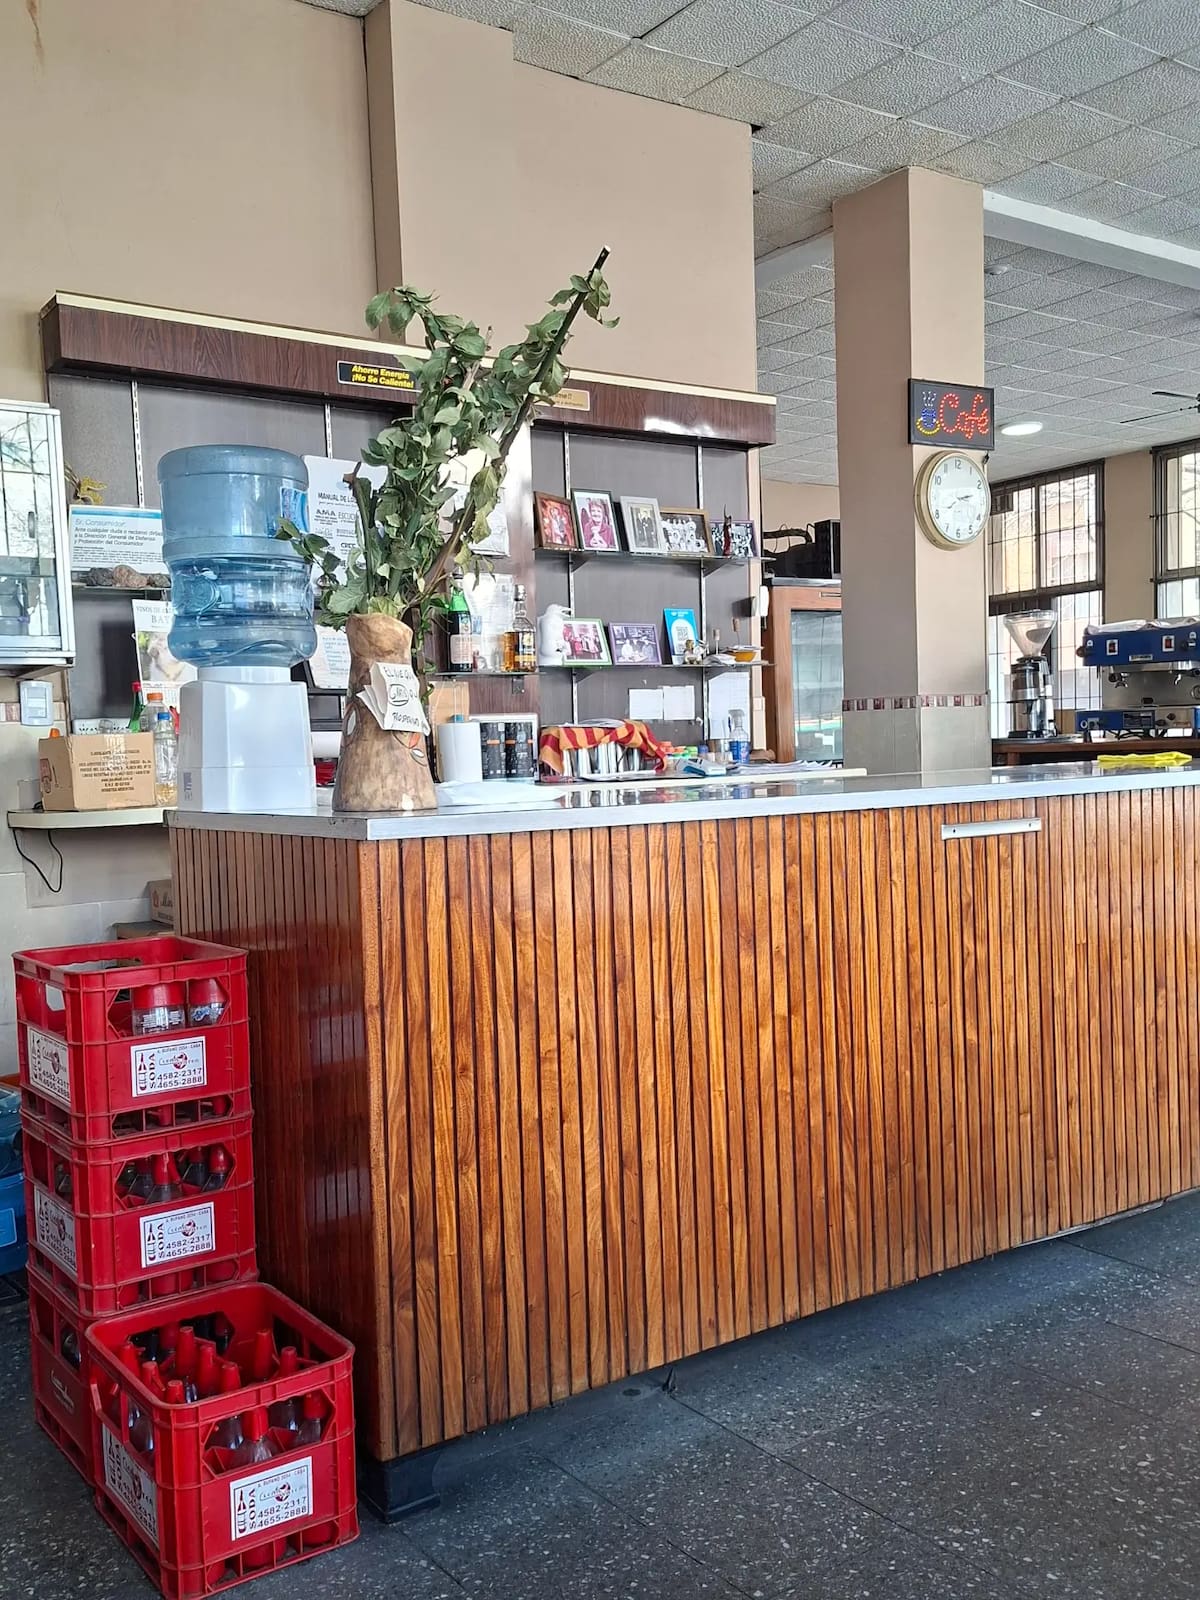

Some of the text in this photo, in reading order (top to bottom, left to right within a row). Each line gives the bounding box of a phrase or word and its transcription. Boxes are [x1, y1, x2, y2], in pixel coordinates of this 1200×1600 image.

[379, 377, 414, 389] Caliente!
[939, 393, 989, 440] Café
[954, 458, 962, 470] 12
[934, 475, 942, 486] 10
[976, 480, 982, 490] 2
[318, 492, 339, 502] MANUAL
[340, 495, 347, 503] DE
[934, 509, 940, 519] 8
[85, 519, 126, 527] Consumidor
[968, 524, 973, 535] 5
[955, 528, 961, 538] 6
[148, 1053, 156, 1089] SODA
[157, 1067, 202, 1081] 4582-2317
[157, 1076, 202, 1089] 4655-2888
[157, 1223, 165, 1258] SODA
[166, 1233, 210, 1249] 4582-2317
[166, 1242, 211, 1258] 4655-2888
[248, 1488, 256, 1529] SODA
[257, 1496, 307, 1518] 4582-2317
[257, 1506, 307, 1528] 4655-2888
